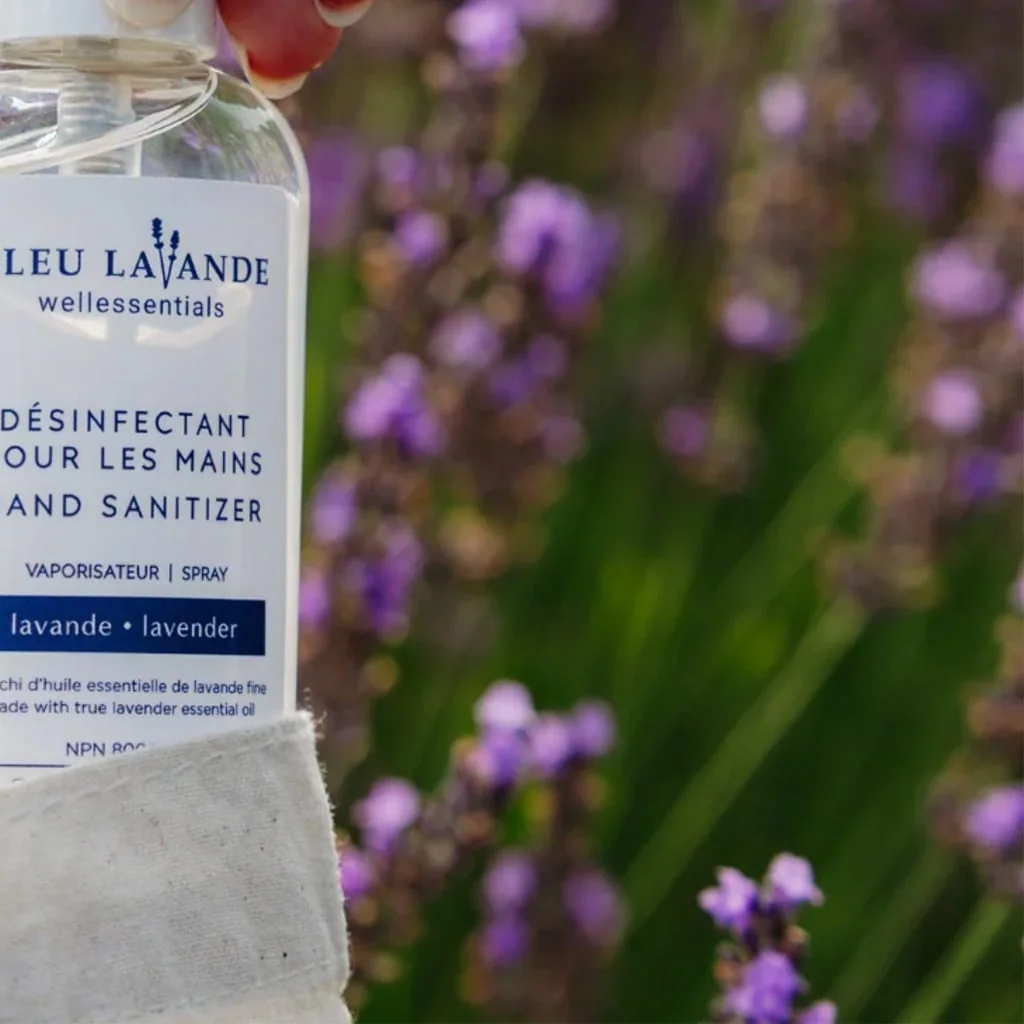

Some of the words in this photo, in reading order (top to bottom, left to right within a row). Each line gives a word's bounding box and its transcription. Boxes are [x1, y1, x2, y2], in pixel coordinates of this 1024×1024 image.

[105, 229, 269, 290] LAVANDE
[38, 291, 225, 318] wellessentials
[0, 401, 250, 438] DÉSINFECTANT
[100, 446, 157, 471] LES
[175, 449, 262, 476] MAINS
[101, 494, 261, 523] SANITIZER
[25, 562, 160, 581] VAPORISATEUR
[181, 565, 229, 582] SPRAY
[11, 612, 112, 636] lavande
[143, 614, 238, 639] lavender
[27, 677, 82, 693] d'huile
[86, 679, 168, 694] essentielle
[171, 679, 190, 694] de
[193, 679, 244, 695] lavande
[246, 680, 267, 696] fine
[33, 699, 70, 714] with
[74, 701, 107, 715] true
[112, 701, 178, 716] lavender
[181, 702, 239, 717] essential
[241, 702, 256, 717] oil
[66, 741, 106, 757] NPN
